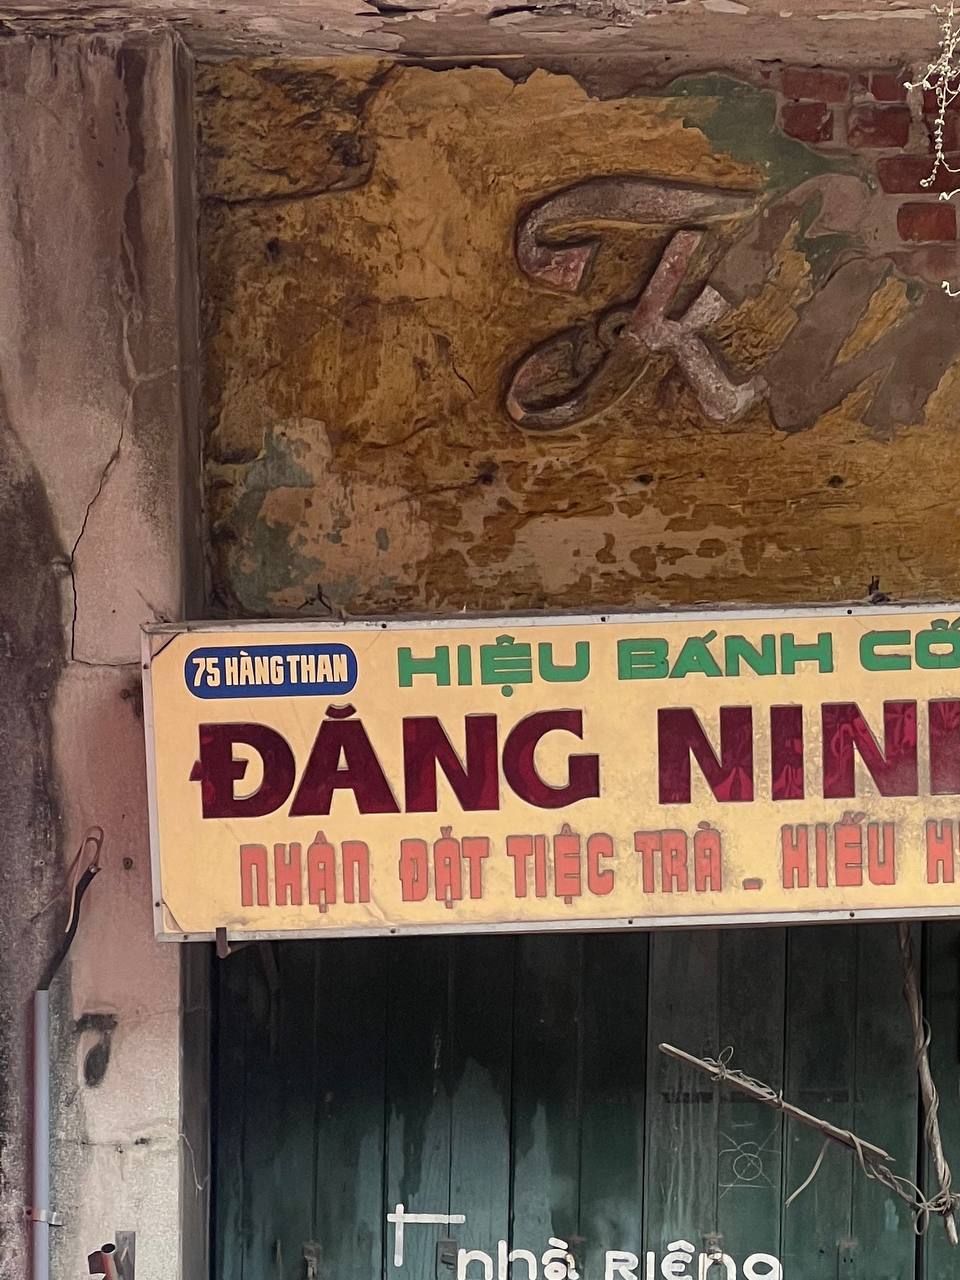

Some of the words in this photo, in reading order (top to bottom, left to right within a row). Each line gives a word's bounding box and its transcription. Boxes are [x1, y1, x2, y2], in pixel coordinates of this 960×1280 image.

[192, 657, 221, 687] 75
[224, 650, 284, 686] HÀNG
[286, 653, 348, 684] THAN
[398, 634, 590, 698] HIỆU
[617, 630, 833, 680] BÁNH
[189, 703, 600, 819] ĐĂNG
[240, 830, 371, 913] NHẬN
[399, 826, 490, 909] ĐẶT
[506, 823, 615, 905] TIỆC
[634, 821, 722, 894] TRÀ
[781, 811, 897, 889] HIẾU
